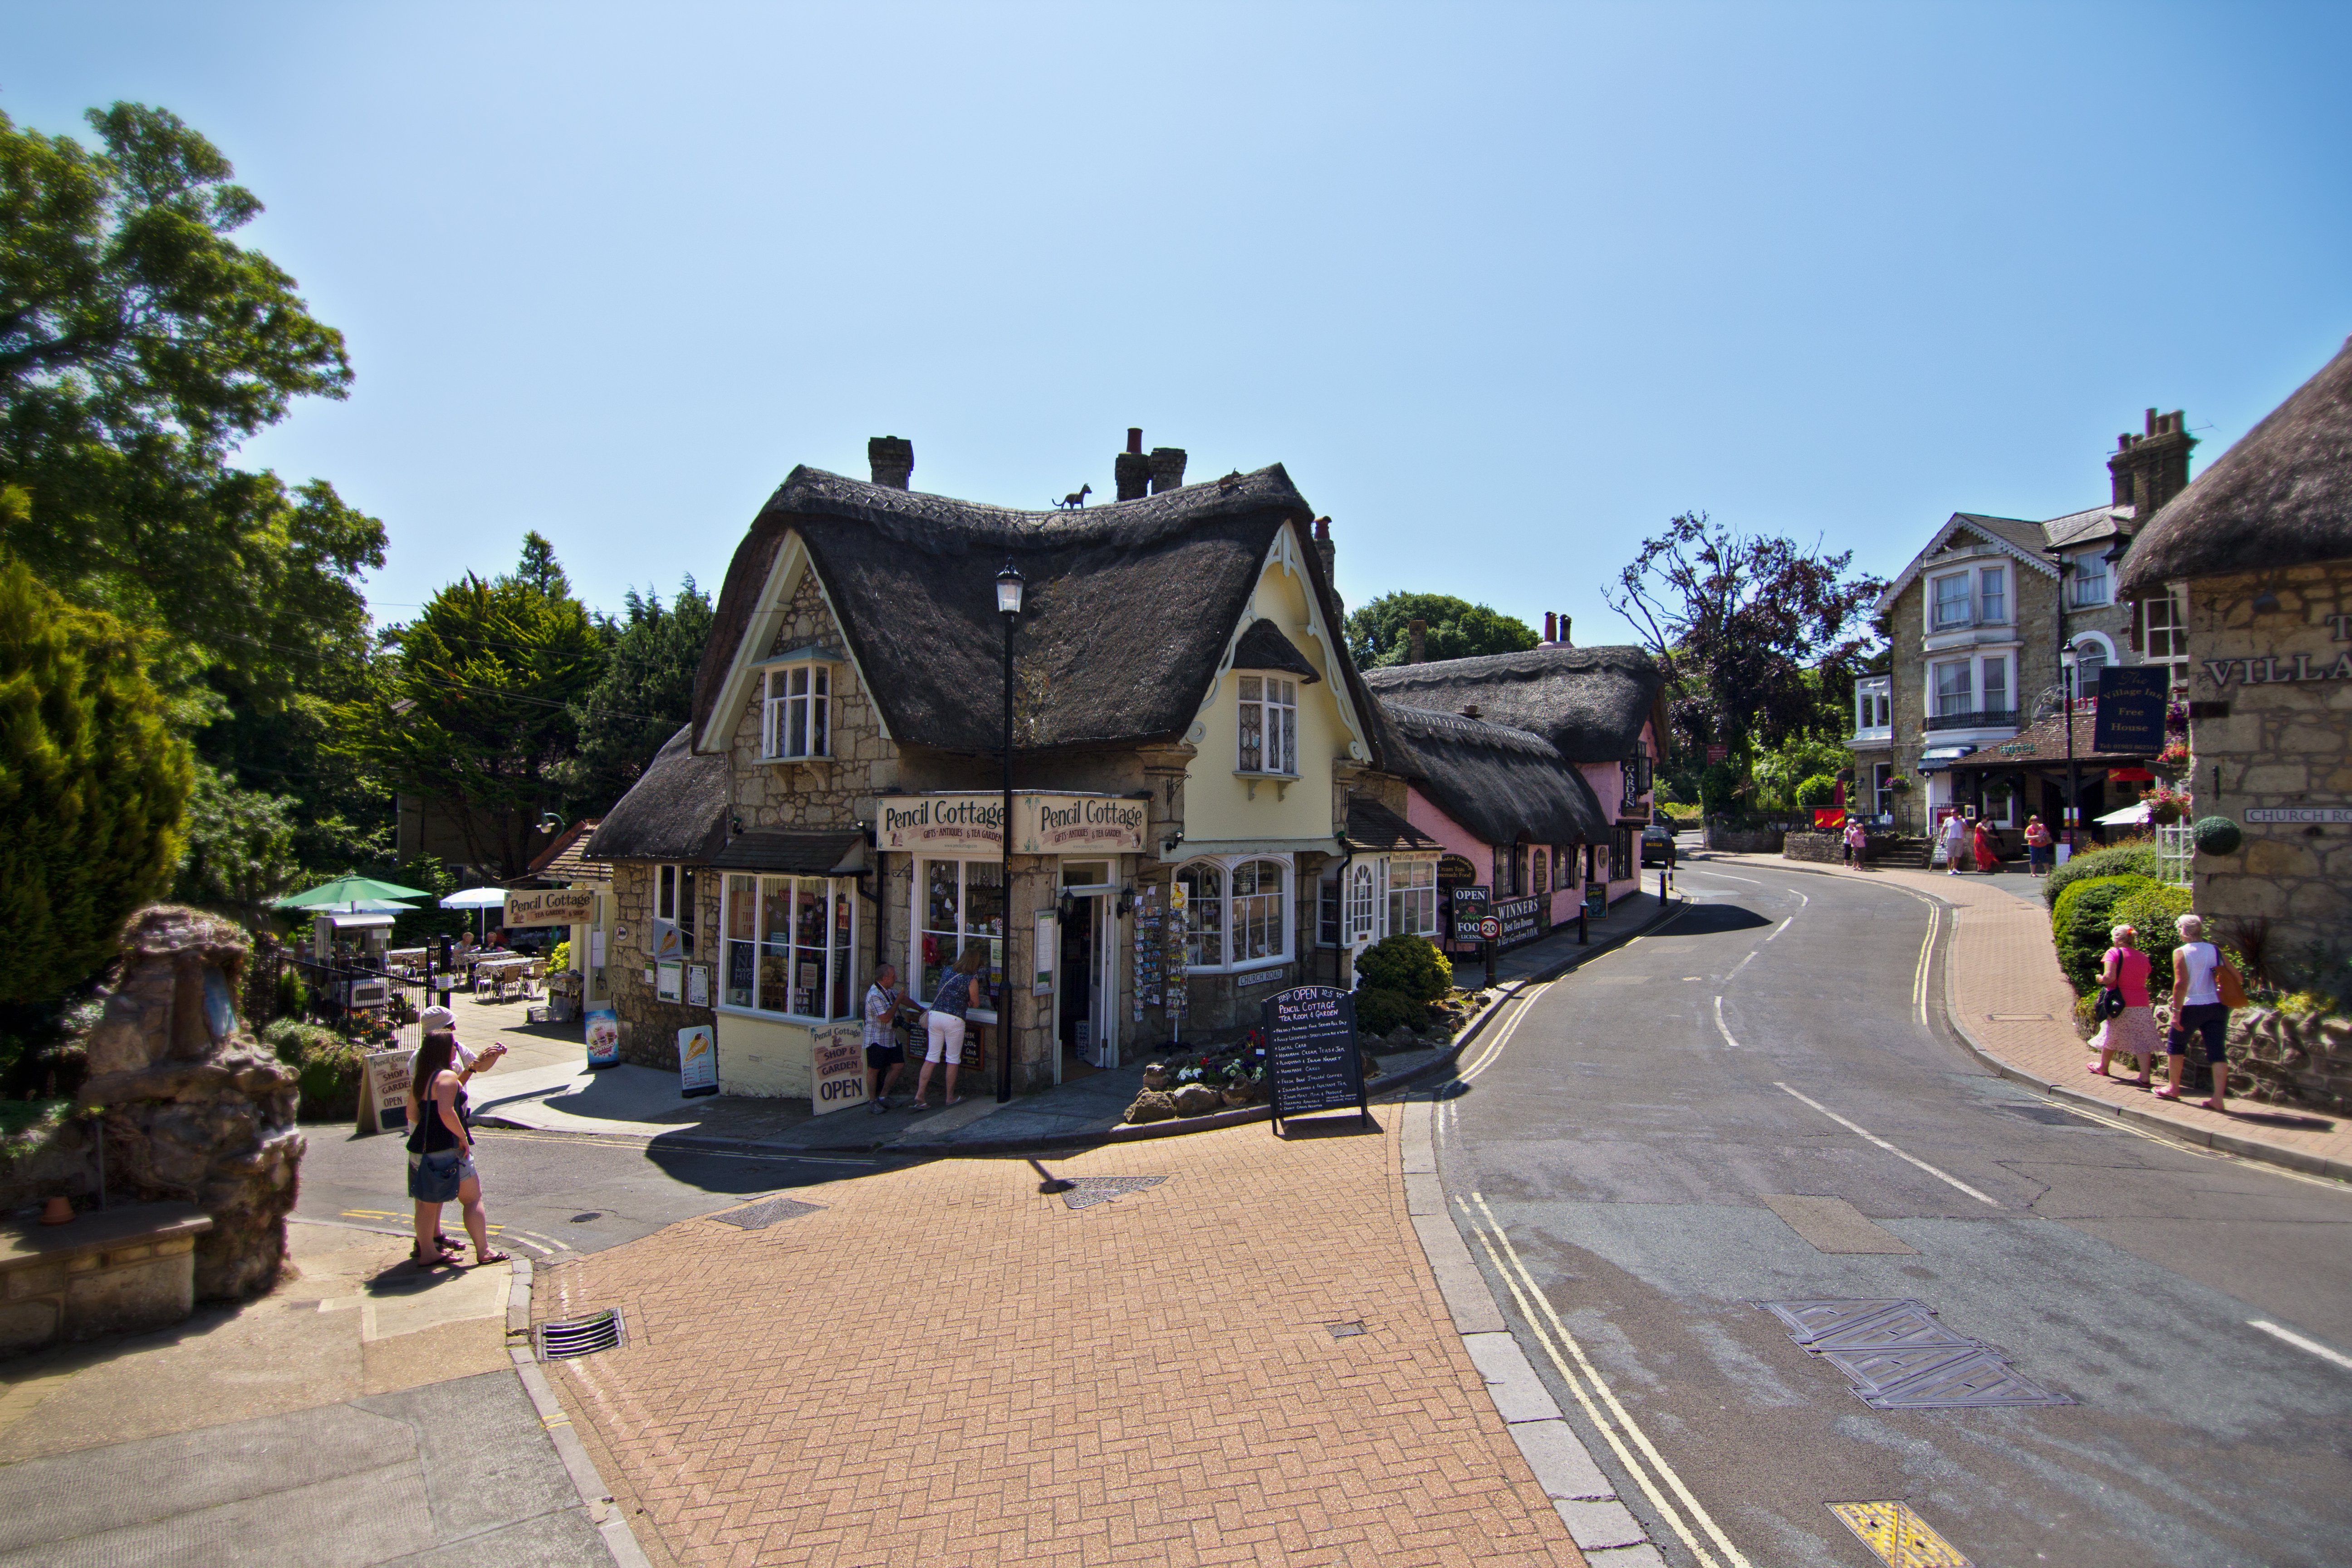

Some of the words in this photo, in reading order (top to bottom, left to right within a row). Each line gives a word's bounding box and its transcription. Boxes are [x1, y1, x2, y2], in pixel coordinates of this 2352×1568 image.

[2203, 653, 2352, 686] VILLA
[2103, 689, 2141, 700] Village
[2145, 688, 2163, 700] Inn
[2118, 707, 2145, 716] Free
[2111, 723, 2149, 731] House
[2000, 744, 2036, 754] HOTEL
[1625, 765, 1635, 807] GARDEN
[886, 801, 928, 831] Pencil
[935, 800, 1004, 829] Cottage
[1041, 800, 1081, 832] Pencil
[1086, 799, 1142, 830] Cottage
[2250, 810, 2324, 821] CHURCH
[2332, 810, 2352, 821] RO
[923, 828, 936, 838] GIFTS
[939, 828, 963, 837] ANTIQUES
[966, 830, 970, 838] &
[971, 829, 980, 838] TEA
[982, 830, 1003, 843] GARDEN
[1055, 833, 1067, 843] GIFTS
[1068, 828, 1088, 839] ANTIQUES
[1096, 829, 1104, 838] TEA
[1105, 829, 1121, 838] GARDEN
[1392, 853, 1401, 861] Pencil
[1456, 890, 1485, 900] OPEN
[511, 895, 541, 913] Pencil
[547, 894, 590, 907] Cottage
[745, 897, 756, 906] LOV
[1498, 899, 1538, 920] WINNERS
[838, 916, 848, 928] FUN
[1457, 922, 1480, 932] FOO
[1504, 923, 1513, 932] Best
[1521, 918, 1534, 928] Rooms
[1509, 931, 1527, 943] Gardens
[1240, 973, 1263, 985] CHURCH
[1266, 970, 1281, 980] ROAD
[1294, 988, 1317, 1000] OPEN
[1279, 1004, 1299, 1014] PENCIL
[1302, 1001, 1335, 1011] COTTAGE
[1316, 1009, 1338, 1019] GARDEN
[814, 1029, 832, 1042] Pencil
[834, 1028, 861, 1037] Cottage
[593, 1042, 614, 1053] shmoo
[824, 1048, 847, 1060] SHOP
[850, 1046, 856, 1054] &
[374, 1056, 390, 1068] Pencil
[822, 1060, 858, 1075] GARDEN
[383, 1070, 404, 1081] SHOP
[821, 1078, 863, 1101] OPEN
[384, 1096, 402, 1107] OPEN
